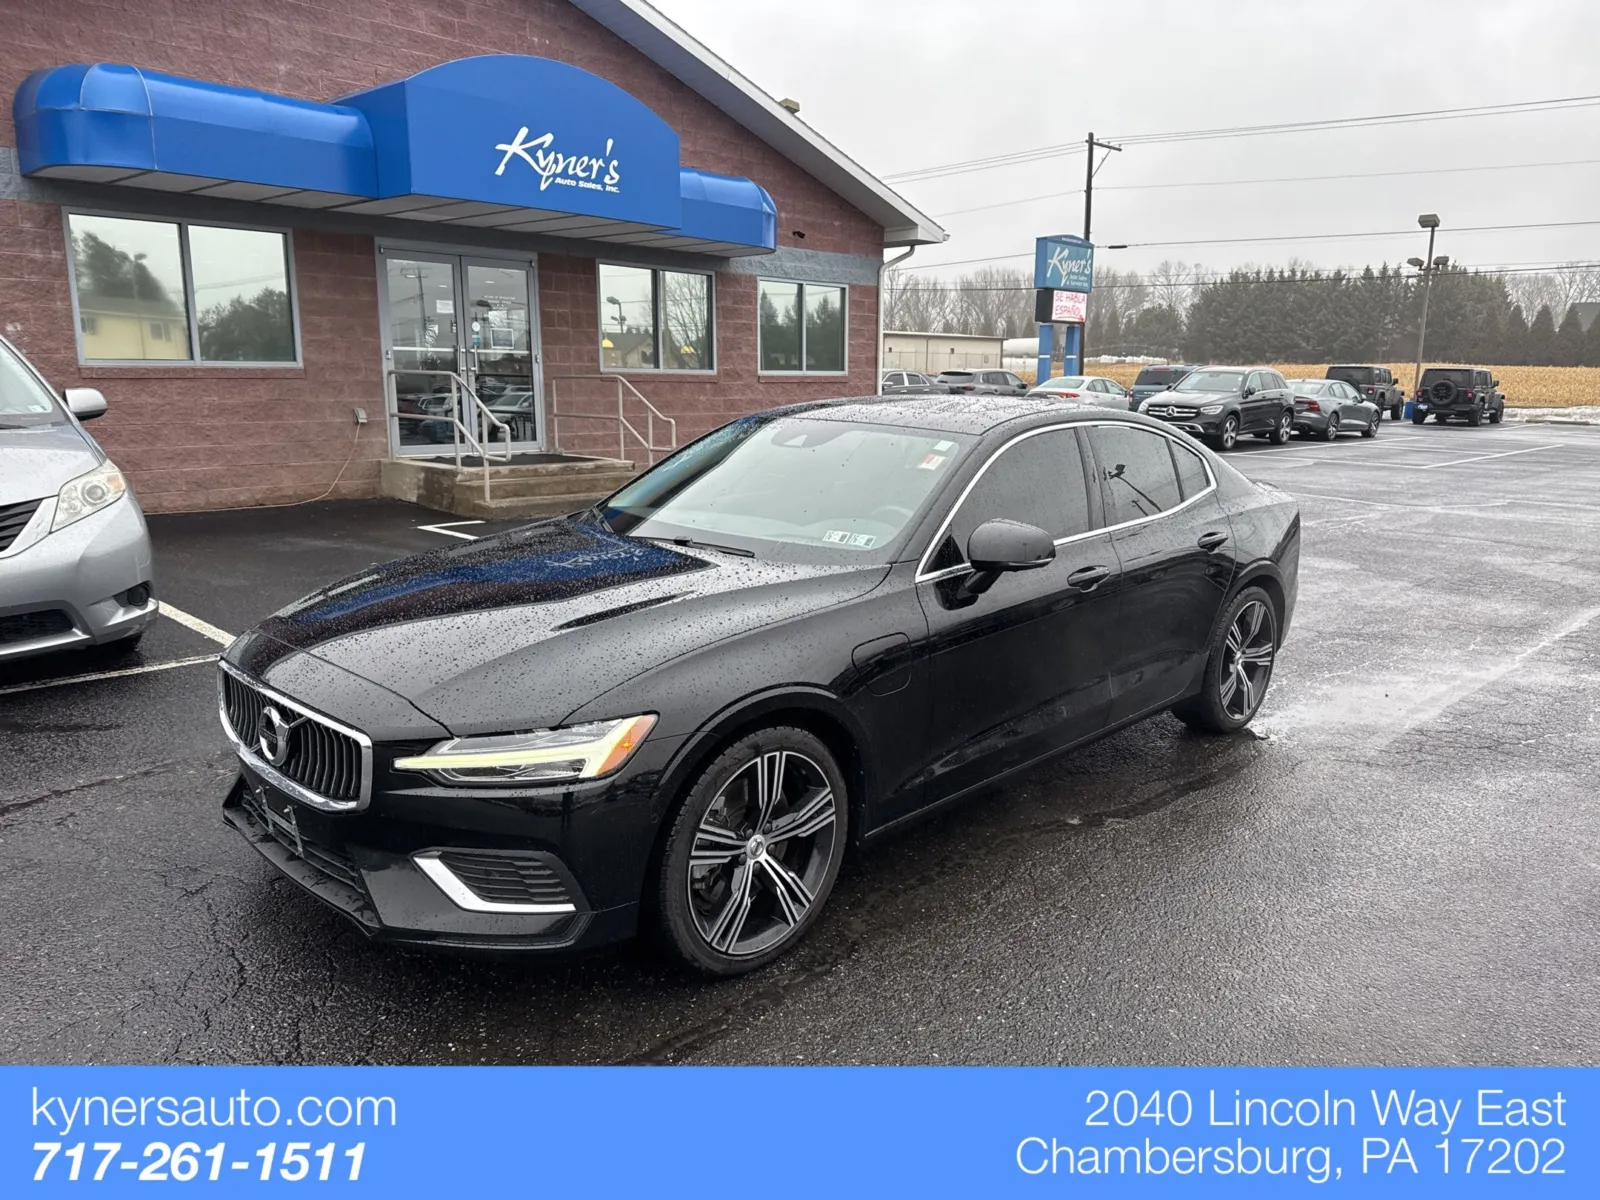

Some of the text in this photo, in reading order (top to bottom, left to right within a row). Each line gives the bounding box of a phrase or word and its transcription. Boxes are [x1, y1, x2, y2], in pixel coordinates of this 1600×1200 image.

[495, 126, 620, 191] Kyner's
[554, 177, 620, 193] Auto Sales, Inc.
[1047, 246, 1091, 287] Kyner's
[1055, 292, 1085, 304] SE HABLA
